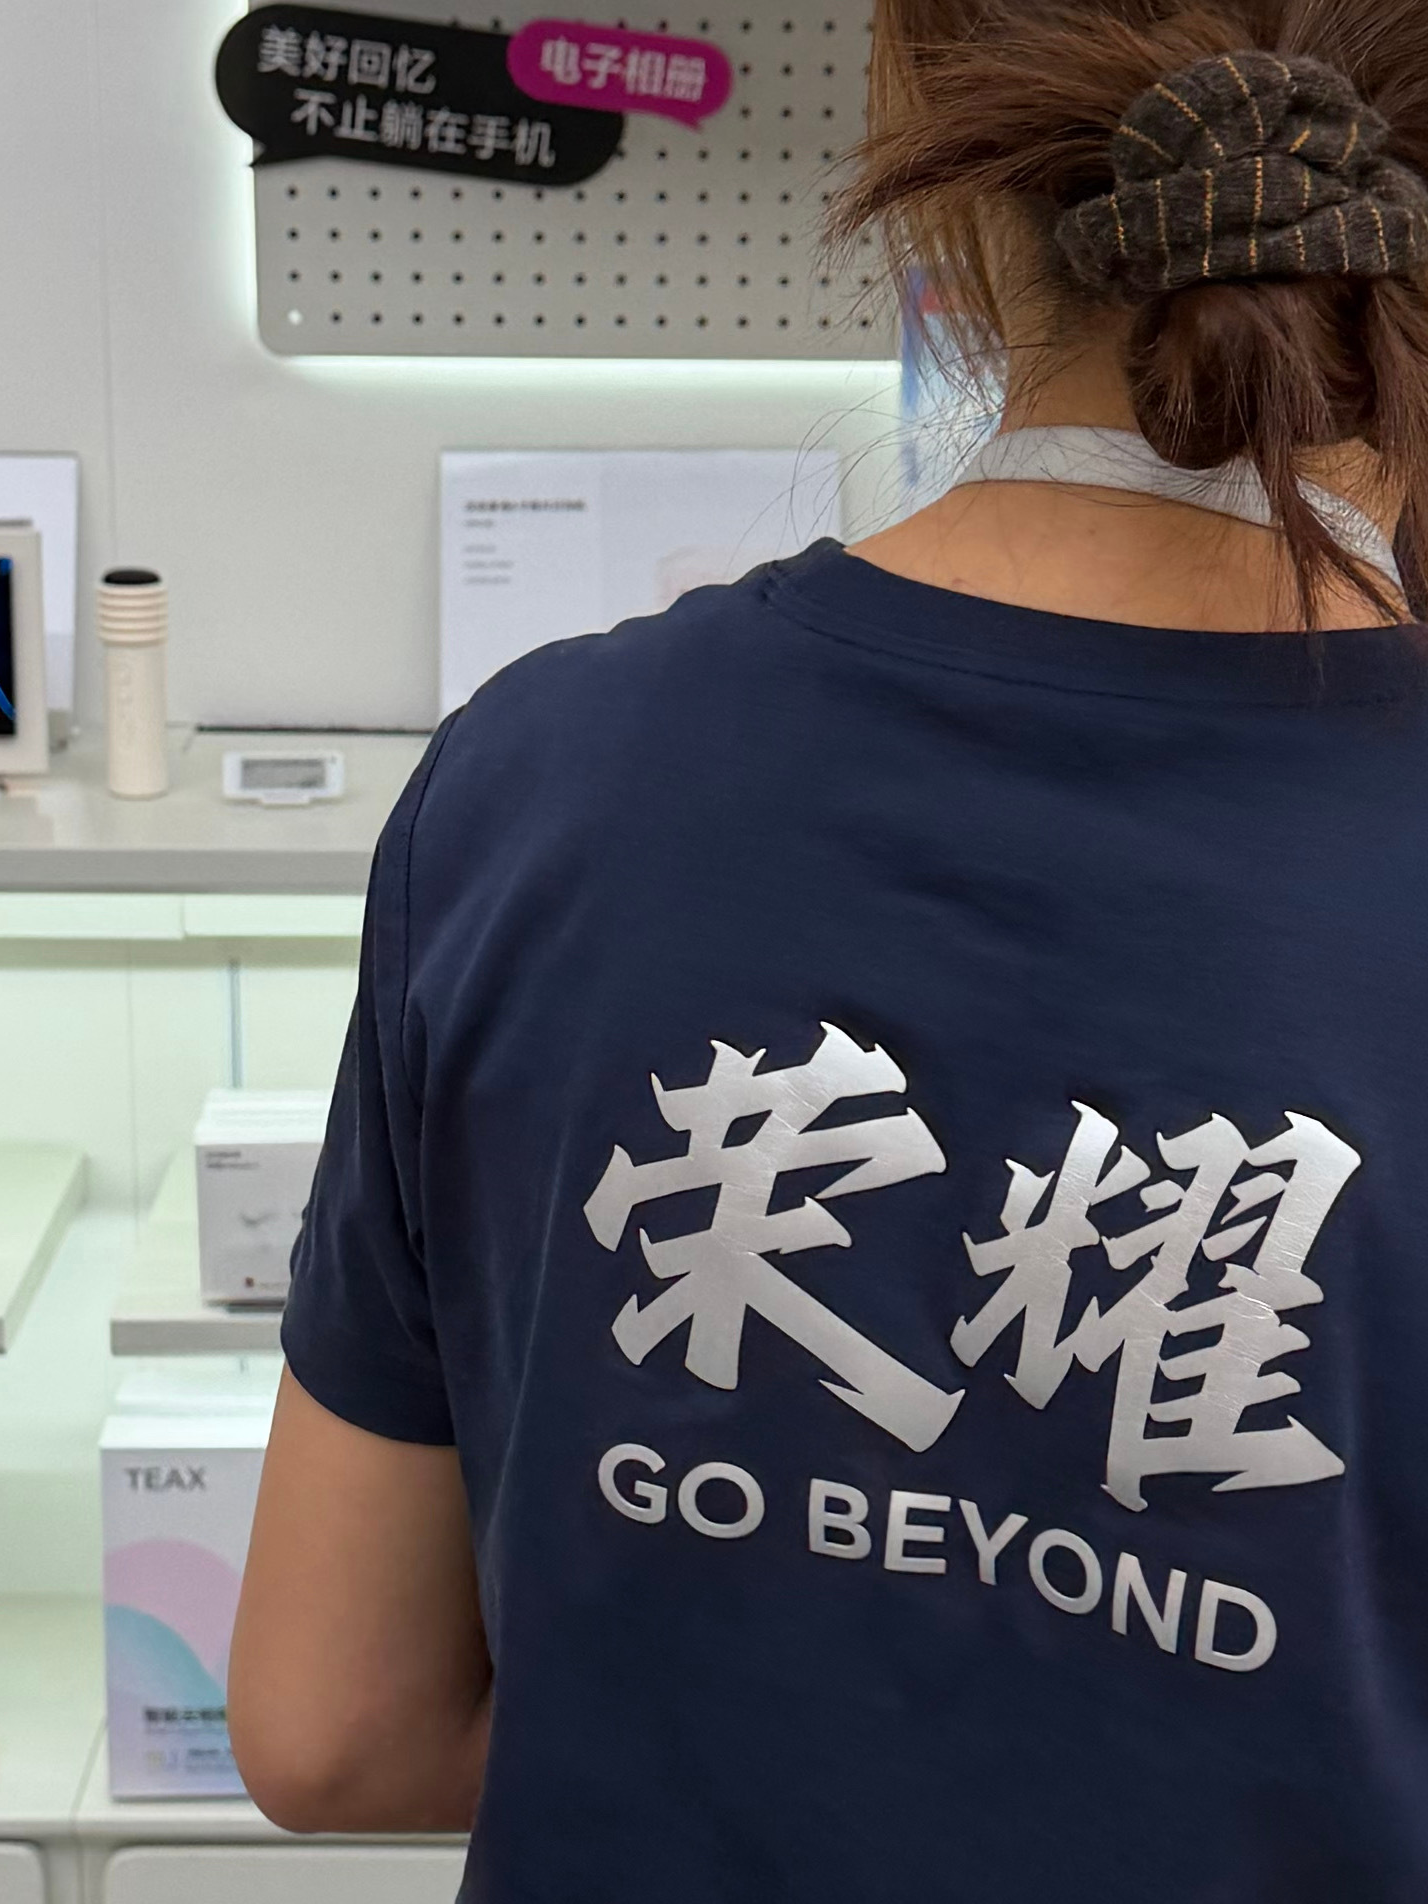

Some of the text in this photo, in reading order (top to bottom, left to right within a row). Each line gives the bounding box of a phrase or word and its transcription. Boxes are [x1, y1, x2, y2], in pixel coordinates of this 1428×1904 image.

[257, 23, 438, 95] 美好回忆
[539, 34, 708, 104] 电子相册
[289, 88, 557, 169] 不止躺在手机
[583, 1021, 1363, 1514] 荣耀
[124, 1465, 207, 1492] TEAX
[597, 1443, 1279, 1674] GO BEYOND
